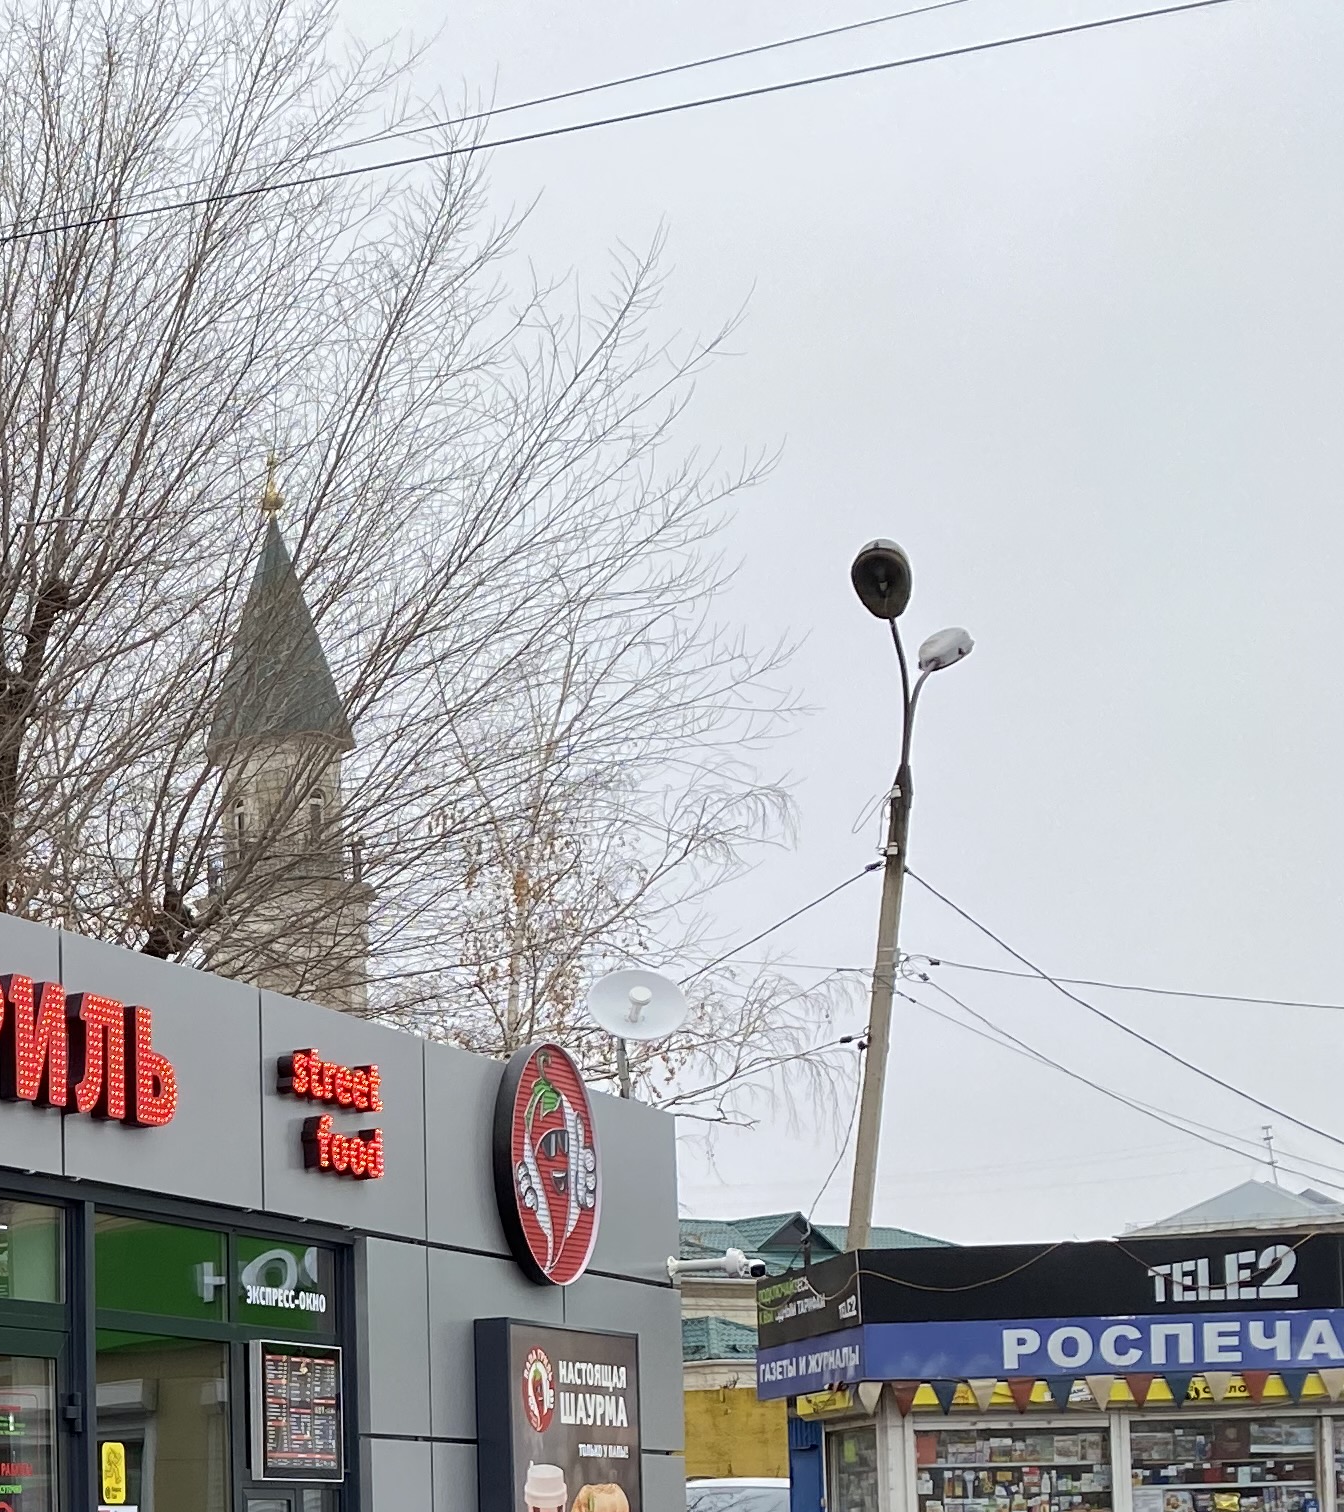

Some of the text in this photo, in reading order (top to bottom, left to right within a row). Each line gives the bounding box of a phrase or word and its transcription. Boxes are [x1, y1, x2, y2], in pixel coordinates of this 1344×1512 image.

[1148, 1245, 1299, 1303] TELE2
[246, 1285, 326, 1313] ЭКСПРЕСС-ОКНО
[1002, 1319, 1344, 1371] РОСПЕЧА
[558, 1360, 627, 1392] НАСТОЯЩАЯ
[759, 1345, 860, 1383] ГАЗЕТЫ И ЖУРНАЛЫ
[559, 1391, 629, 1428] ШАУРМА
